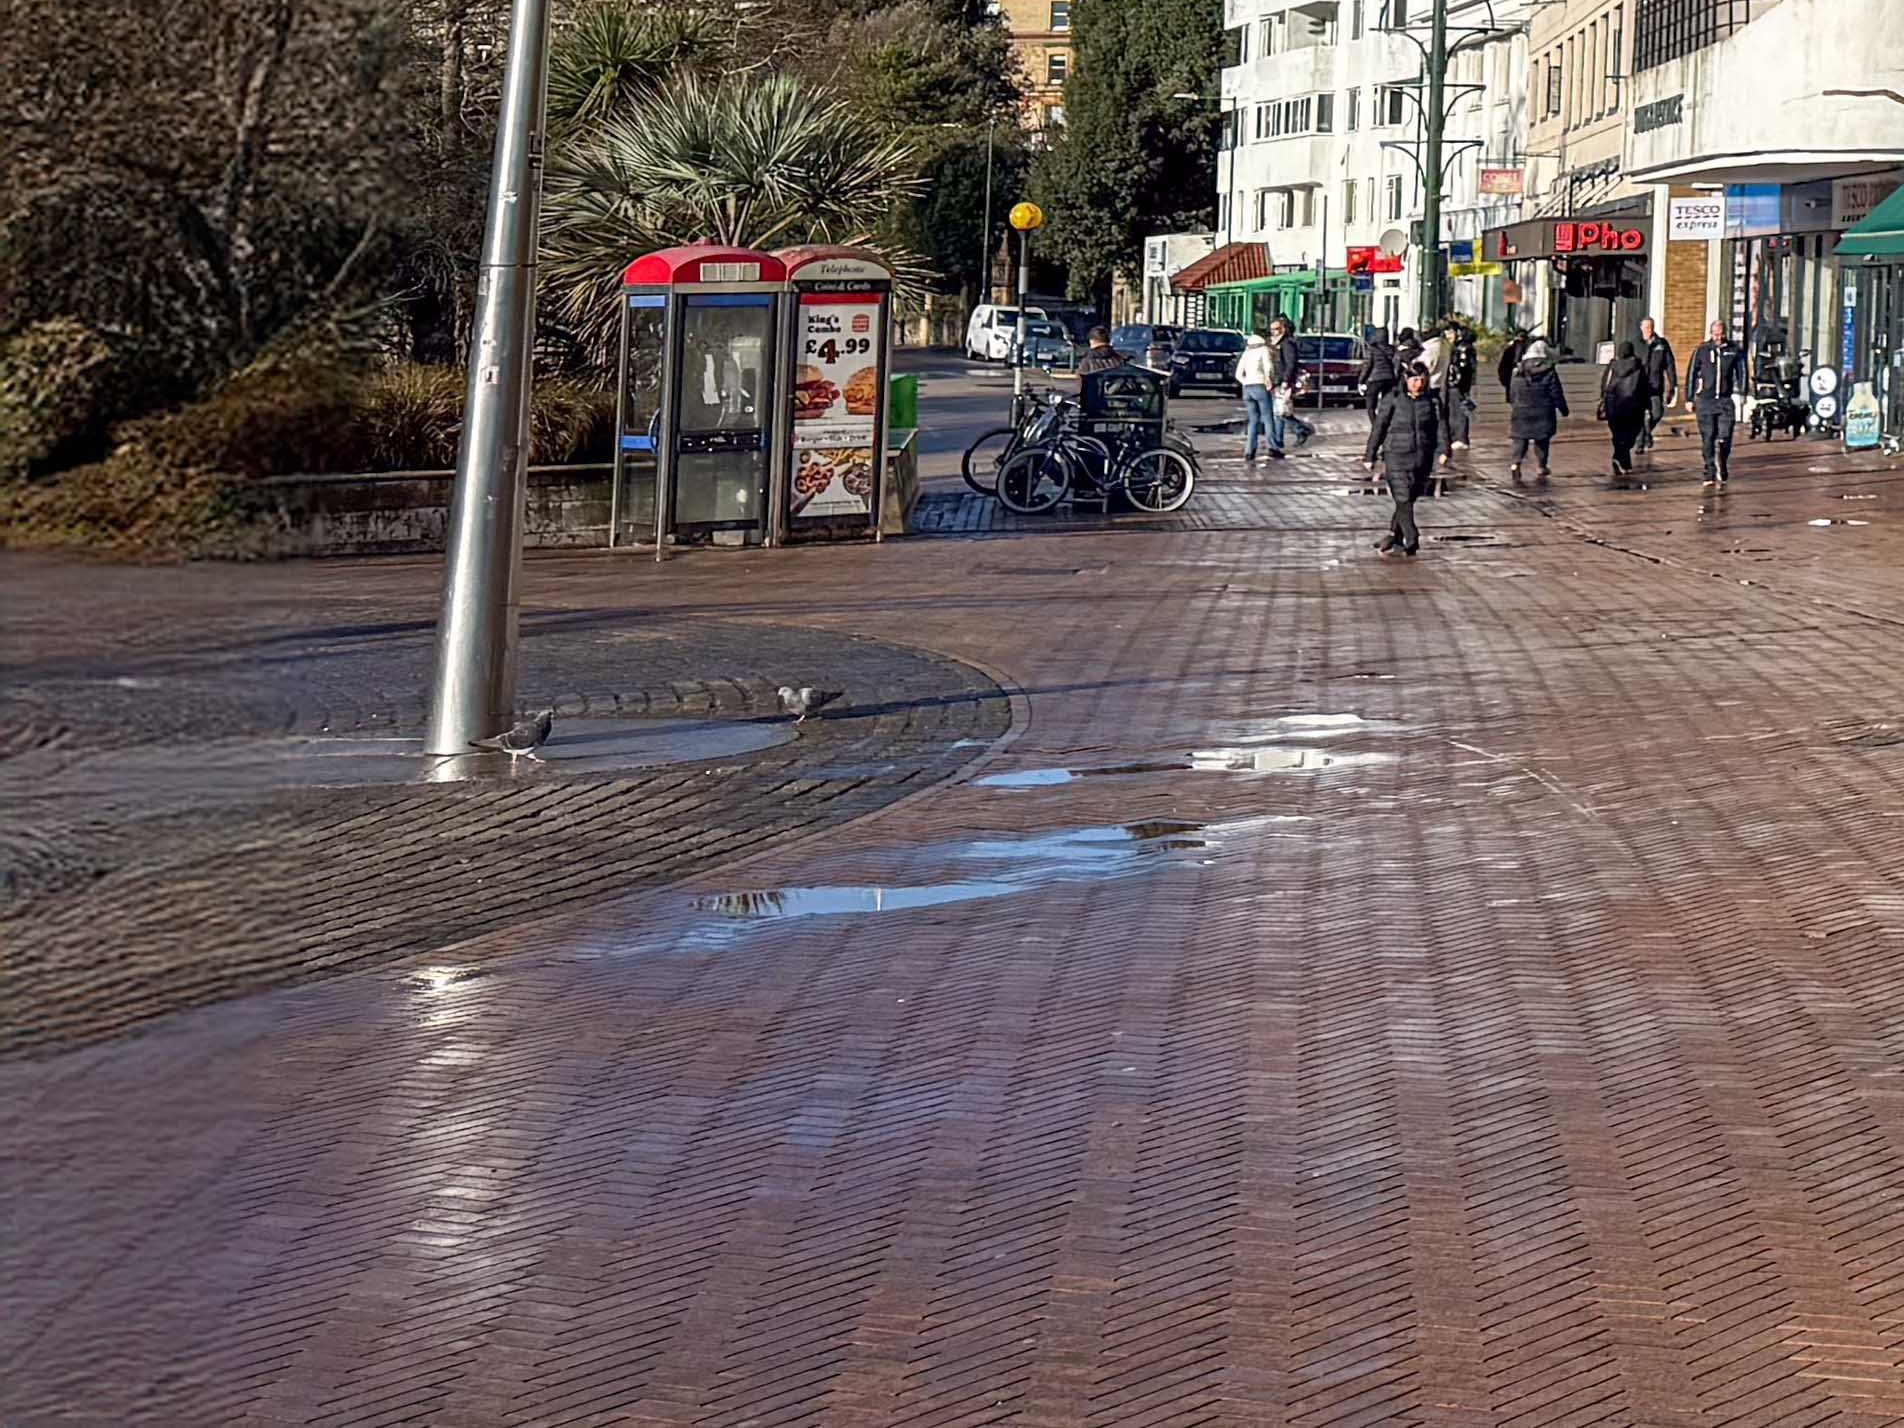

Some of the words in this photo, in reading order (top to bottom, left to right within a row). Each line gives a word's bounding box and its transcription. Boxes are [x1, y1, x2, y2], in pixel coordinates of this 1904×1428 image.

[1674, 205, 1721, 215] TESCO
[1577, 222, 1645, 251] Pho
[820, 264, 866, 275] Telephone
[807, 314, 840, 325] King's
[805, 337, 870, 364] £4.99
